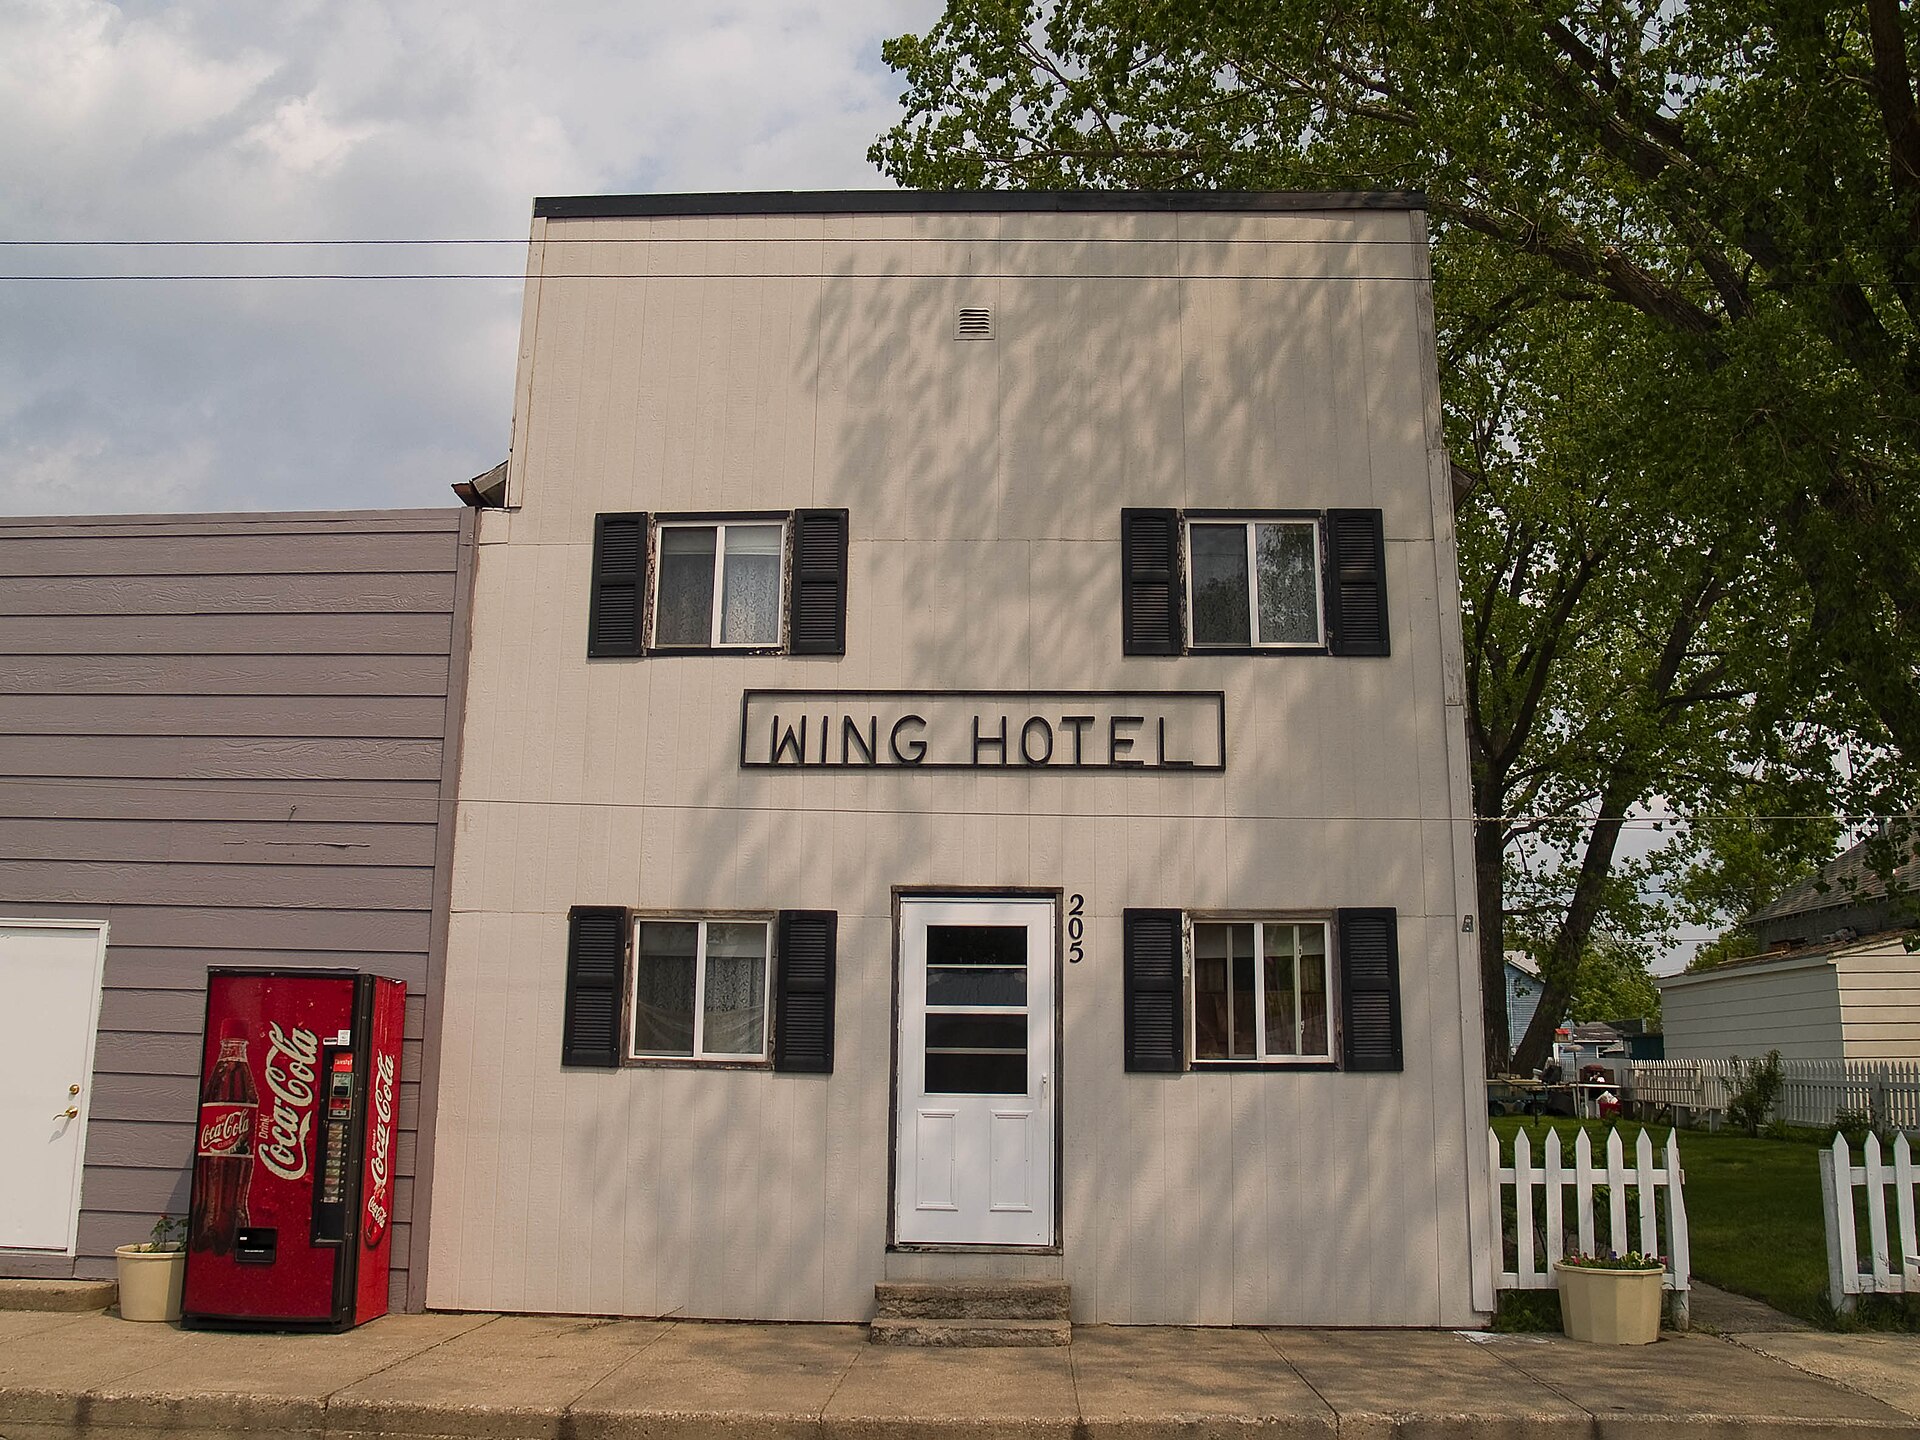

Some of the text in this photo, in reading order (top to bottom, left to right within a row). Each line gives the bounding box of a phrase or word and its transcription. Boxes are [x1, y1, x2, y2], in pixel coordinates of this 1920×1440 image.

[772, 715, 1194, 768] WING HOTEL
[1068, 894, 1084, 963] 205
[258, 1021, 318, 1180] Coca-Cola
[258, 1113, 270, 1140] Drink!
